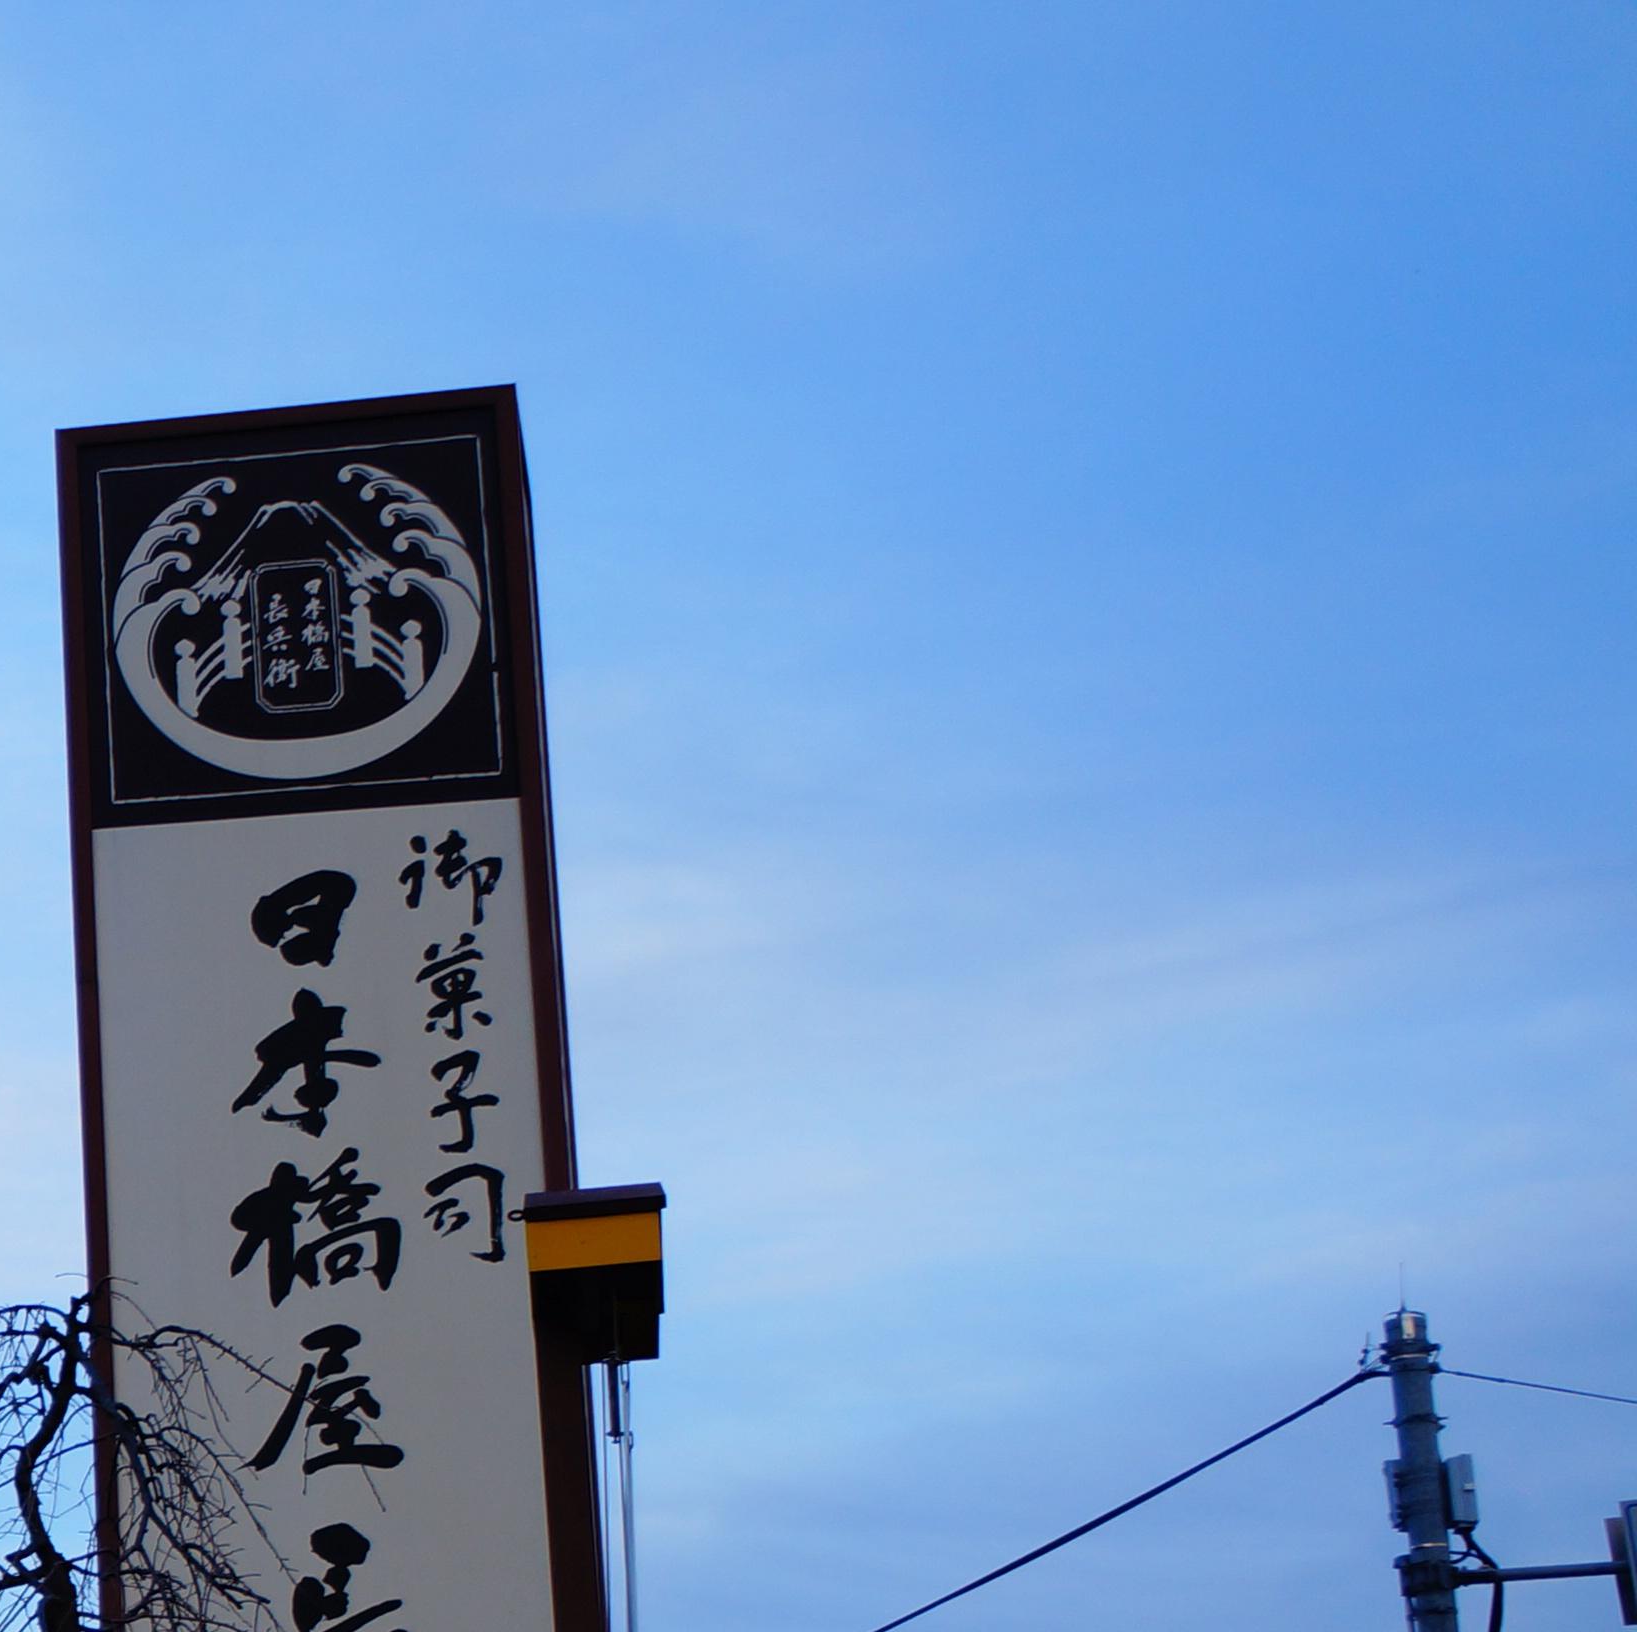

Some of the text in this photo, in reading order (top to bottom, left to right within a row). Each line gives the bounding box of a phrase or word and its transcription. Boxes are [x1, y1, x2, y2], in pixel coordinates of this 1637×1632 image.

[301, 577, 331, 672] 日本橋屋
[398, 830, 506, 1263] 御菓子司
